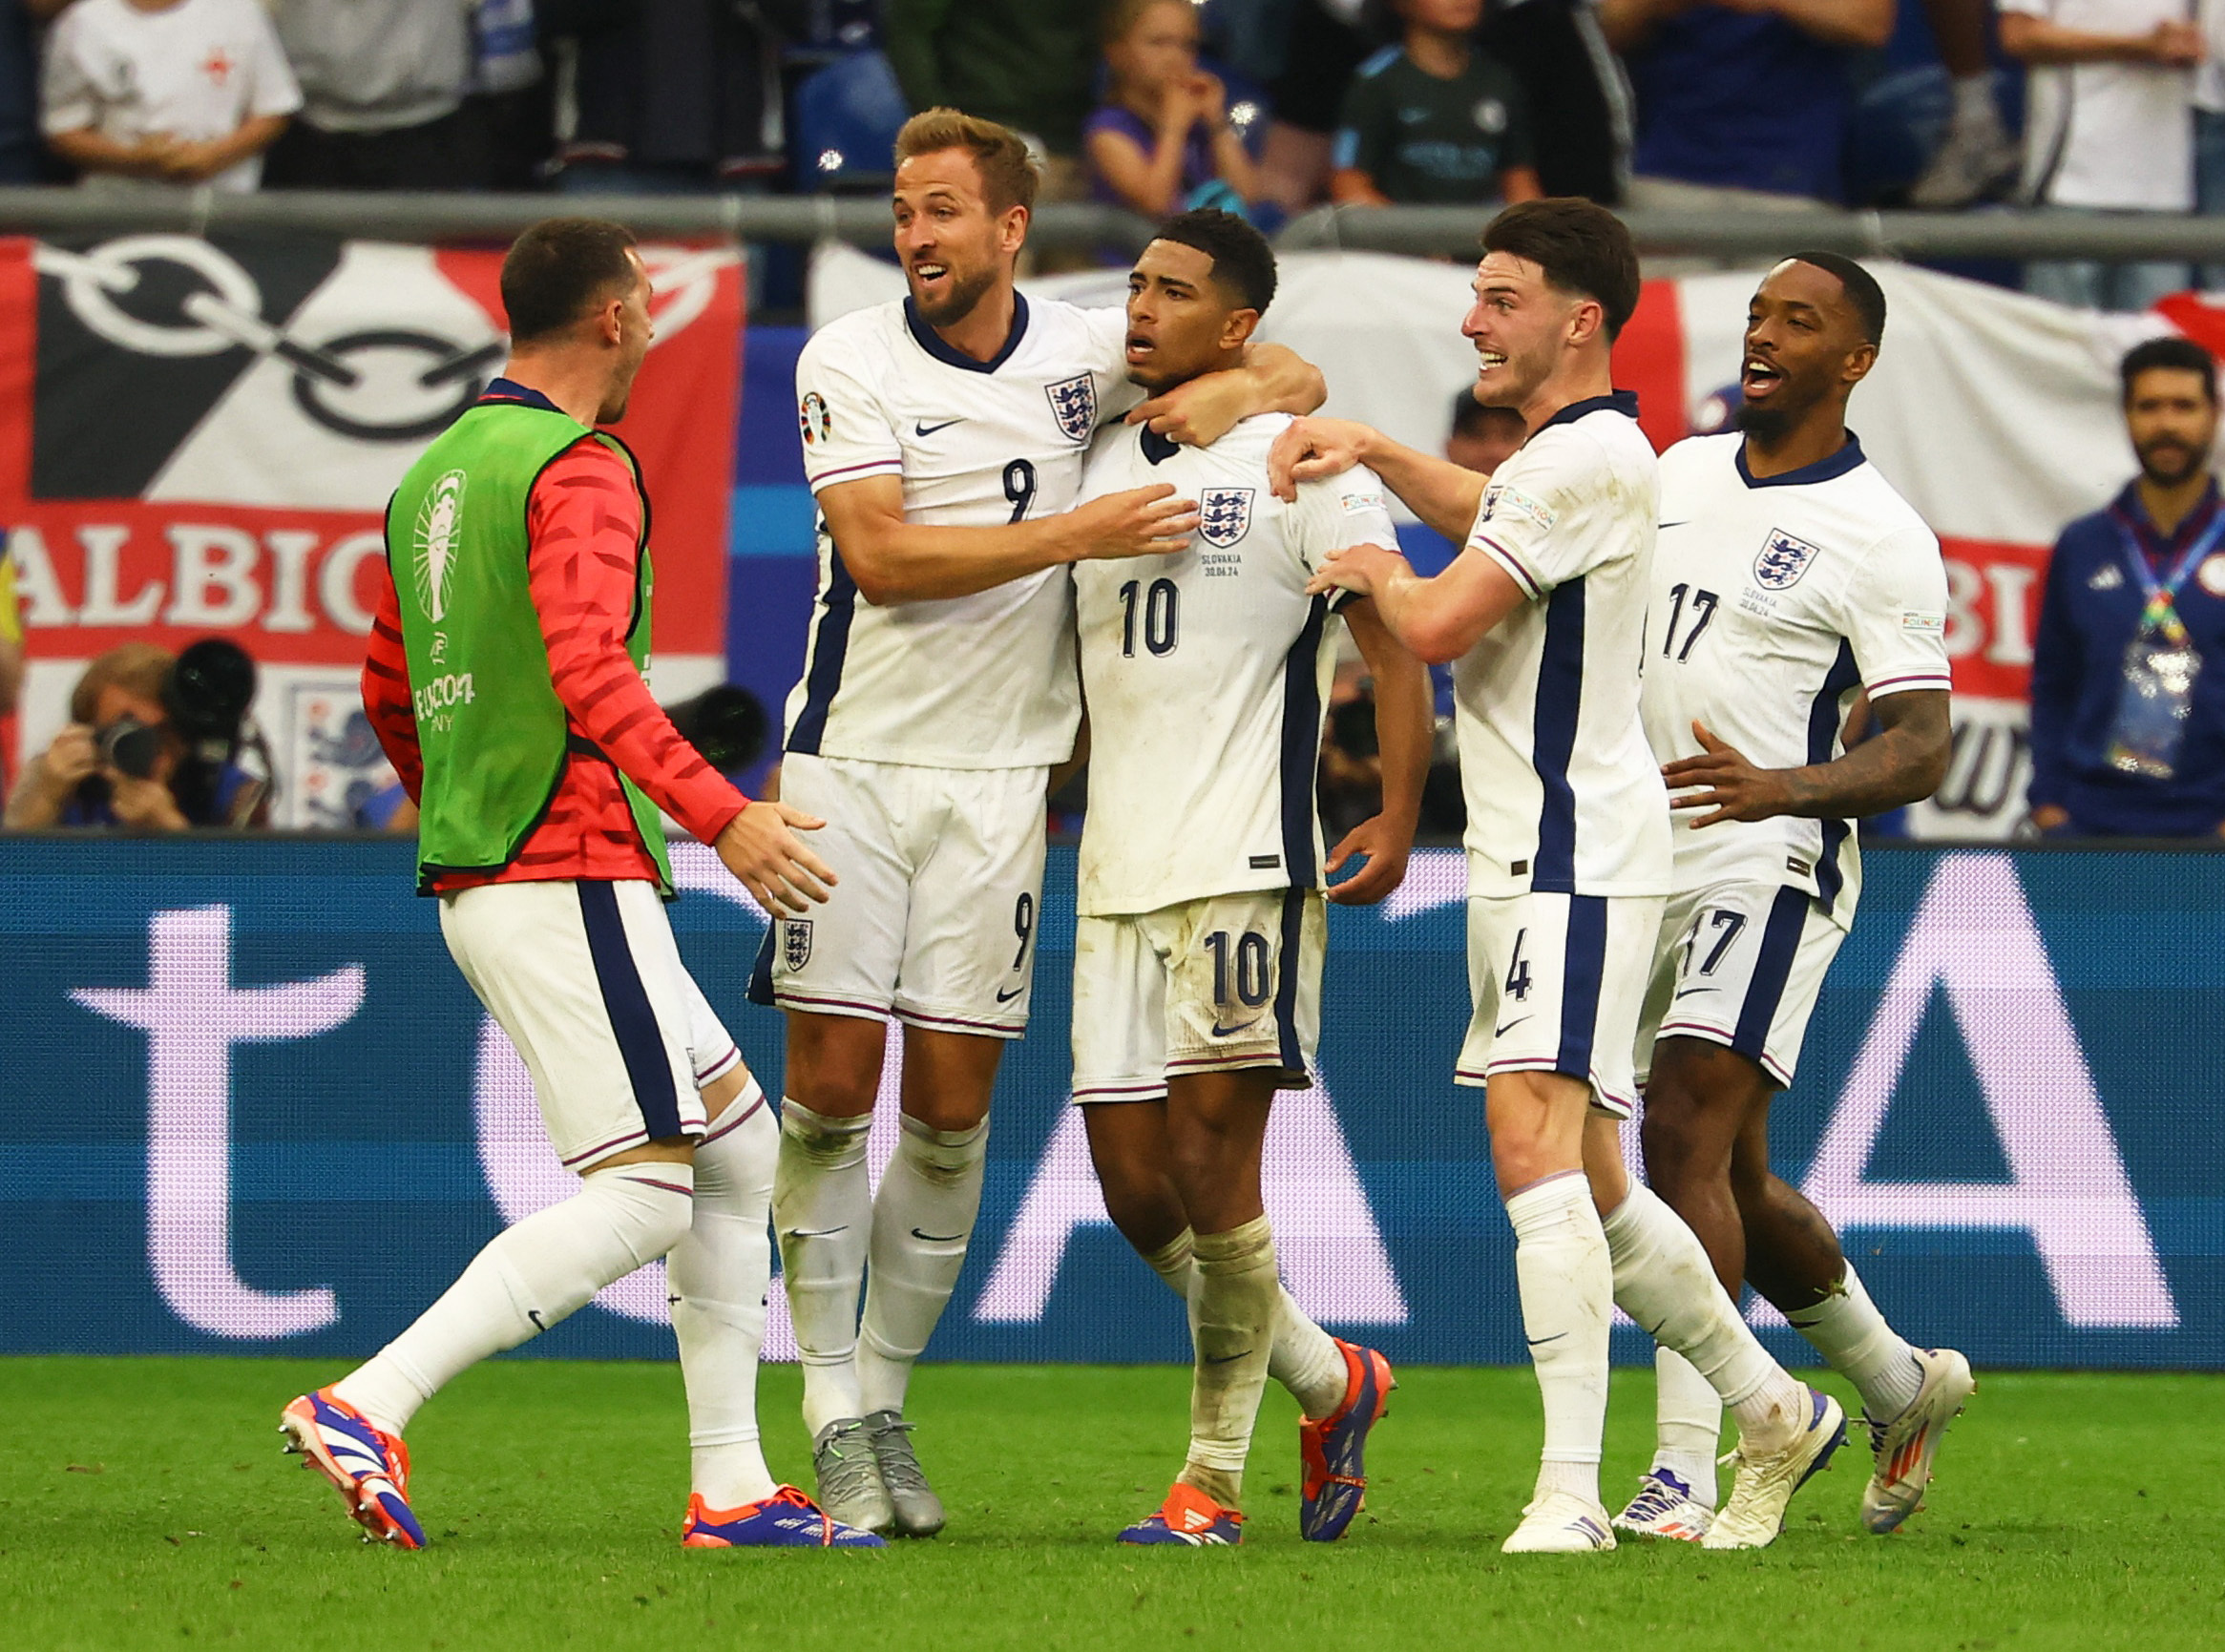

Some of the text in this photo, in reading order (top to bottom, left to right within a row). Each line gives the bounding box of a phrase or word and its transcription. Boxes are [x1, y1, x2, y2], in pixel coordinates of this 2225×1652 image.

[1002, 458, 1038, 525] 9
[1201, 554, 1243, 565] SLOVAKIA
[1120, 577, 1180, 658] 10
[1663, 582, 1720, 664] 17
[1015, 891, 1034, 972] 9
[1505, 927, 1533, 1002] 4
[1681, 910, 1748, 976] 17
[1204, 931, 1272, 1009] 10
